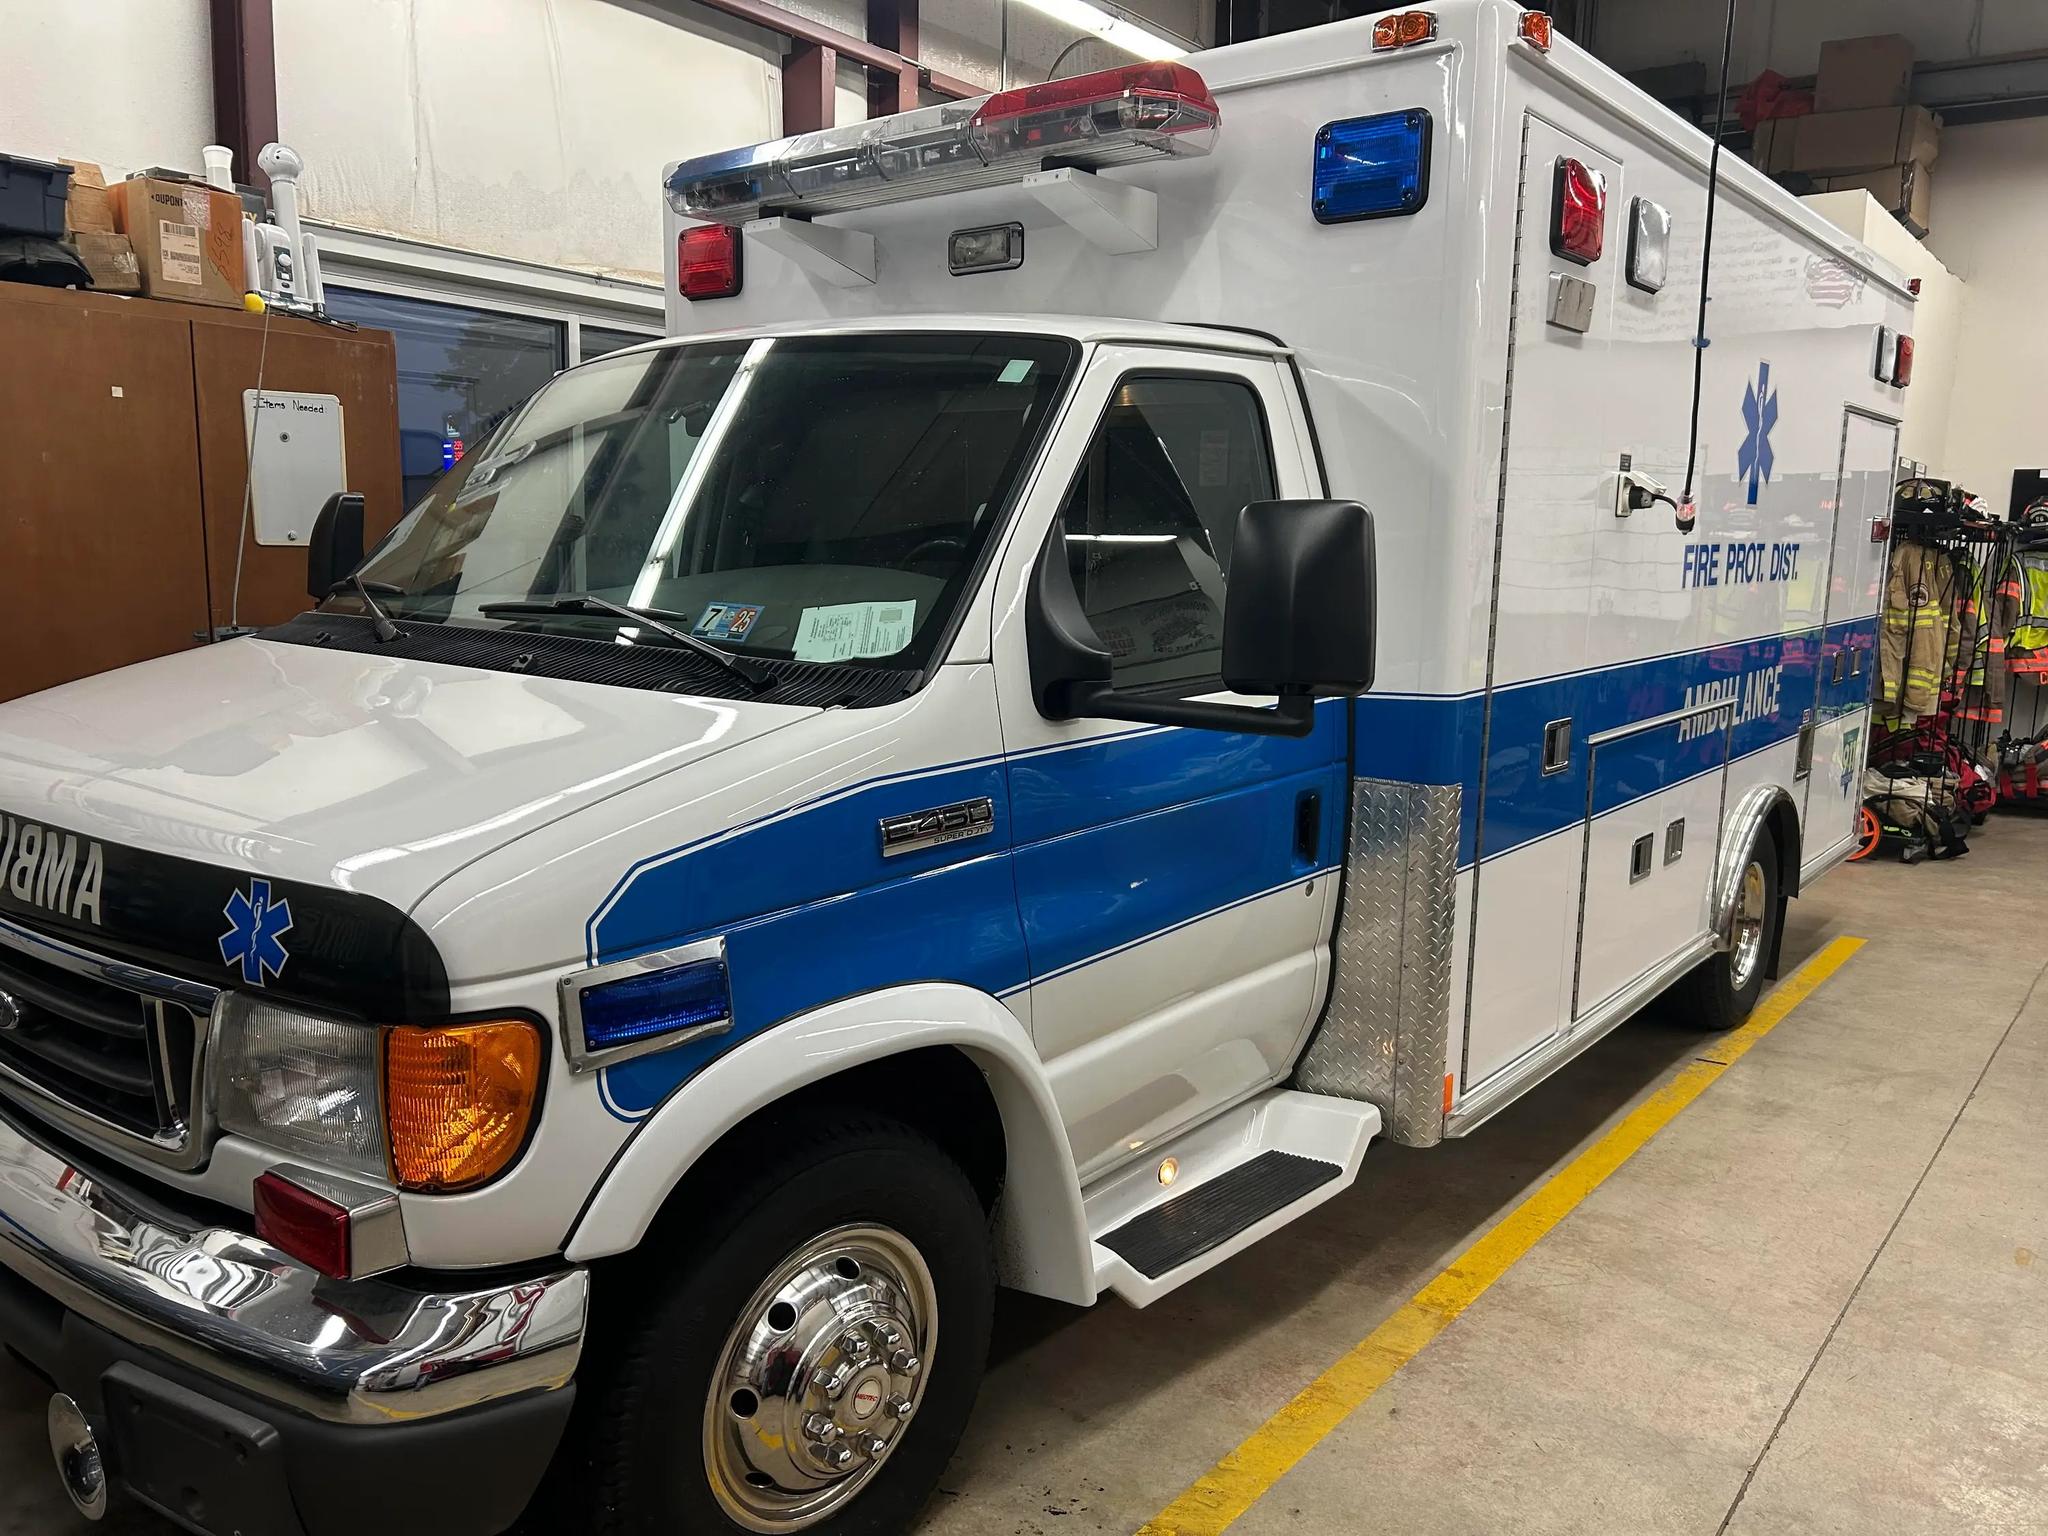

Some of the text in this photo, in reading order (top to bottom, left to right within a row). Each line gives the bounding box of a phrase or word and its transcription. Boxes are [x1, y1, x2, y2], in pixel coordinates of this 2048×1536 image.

[155, 193, 183, 207] DUPONT
[252, 397, 286, 410] Items
[1682, 542, 1799, 588] FIRE PROT. DIST.
[702, 607, 723, 628] 7
[729, 610, 756, 633] 25
[1677, 664, 1783, 744] AMBULANCE
[933, 830, 965, 844] SUPER
